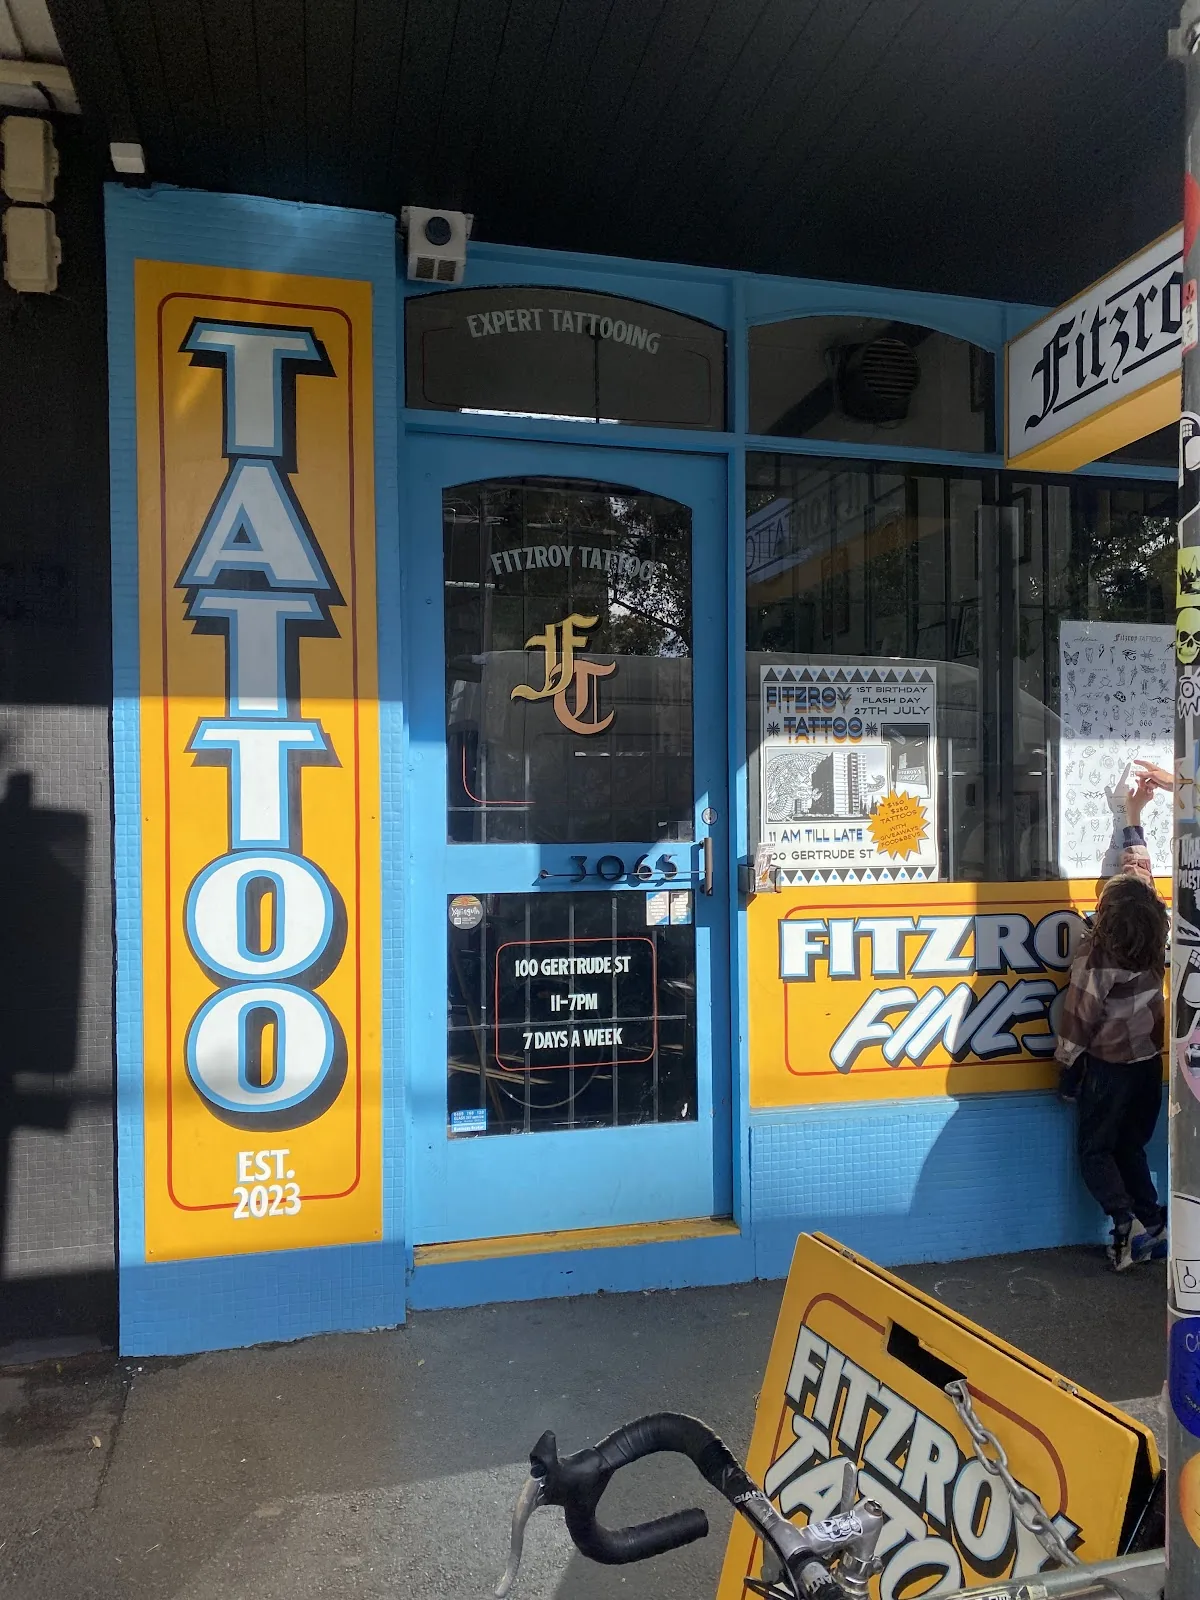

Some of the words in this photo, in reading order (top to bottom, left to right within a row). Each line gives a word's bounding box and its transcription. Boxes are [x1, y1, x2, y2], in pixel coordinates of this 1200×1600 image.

[466, 308, 544, 338] EXPERT
[548, 308, 662, 355] TATTOOING
[1024, 271, 1183, 434] Fitzro
[490, 544, 574, 576] FITZROY
[578, 546, 655, 582] TATTOO
[766, 686, 852, 714] FITZROY
[854, 706, 888, 715] 27TH
[893, 706, 930, 715] JULY
[175, 317, 347, 1131] TATTOO
[783, 716, 863, 744] TATTOO
[880, 809, 917, 824] TATTOOS
[889, 823, 907, 832] WITH
[768, 831, 776, 842] 11
[781, 829, 800, 843] AM
[805, 828, 830, 843] TILL
[834, 828, 863, 843] LATE
[880, 825, 919, 841] GIVEAWAYS
[570, 853, 678, 883] 3065
[771, 852, 787, 861] 00
[791, 849, 855, 861] GERTRUDE
[859, 849, 874, 859] ST
[778, 910, 1094, 982] FITZRO
[515, 959, 538, 978] 100
[540, 957, 612, 976] GERTRUDE
[614, 956, 631, 973] ST
[522, 1032, 533, 1050] 7
[534, 1030, 569, 1049] DAYS
[570, 1030, 580, 1048] A
[583, 1028, 623, 1046] WEEK
[236, 1148, 296, 1184] EST.
[232, 1182, 302, 1220] 2023
